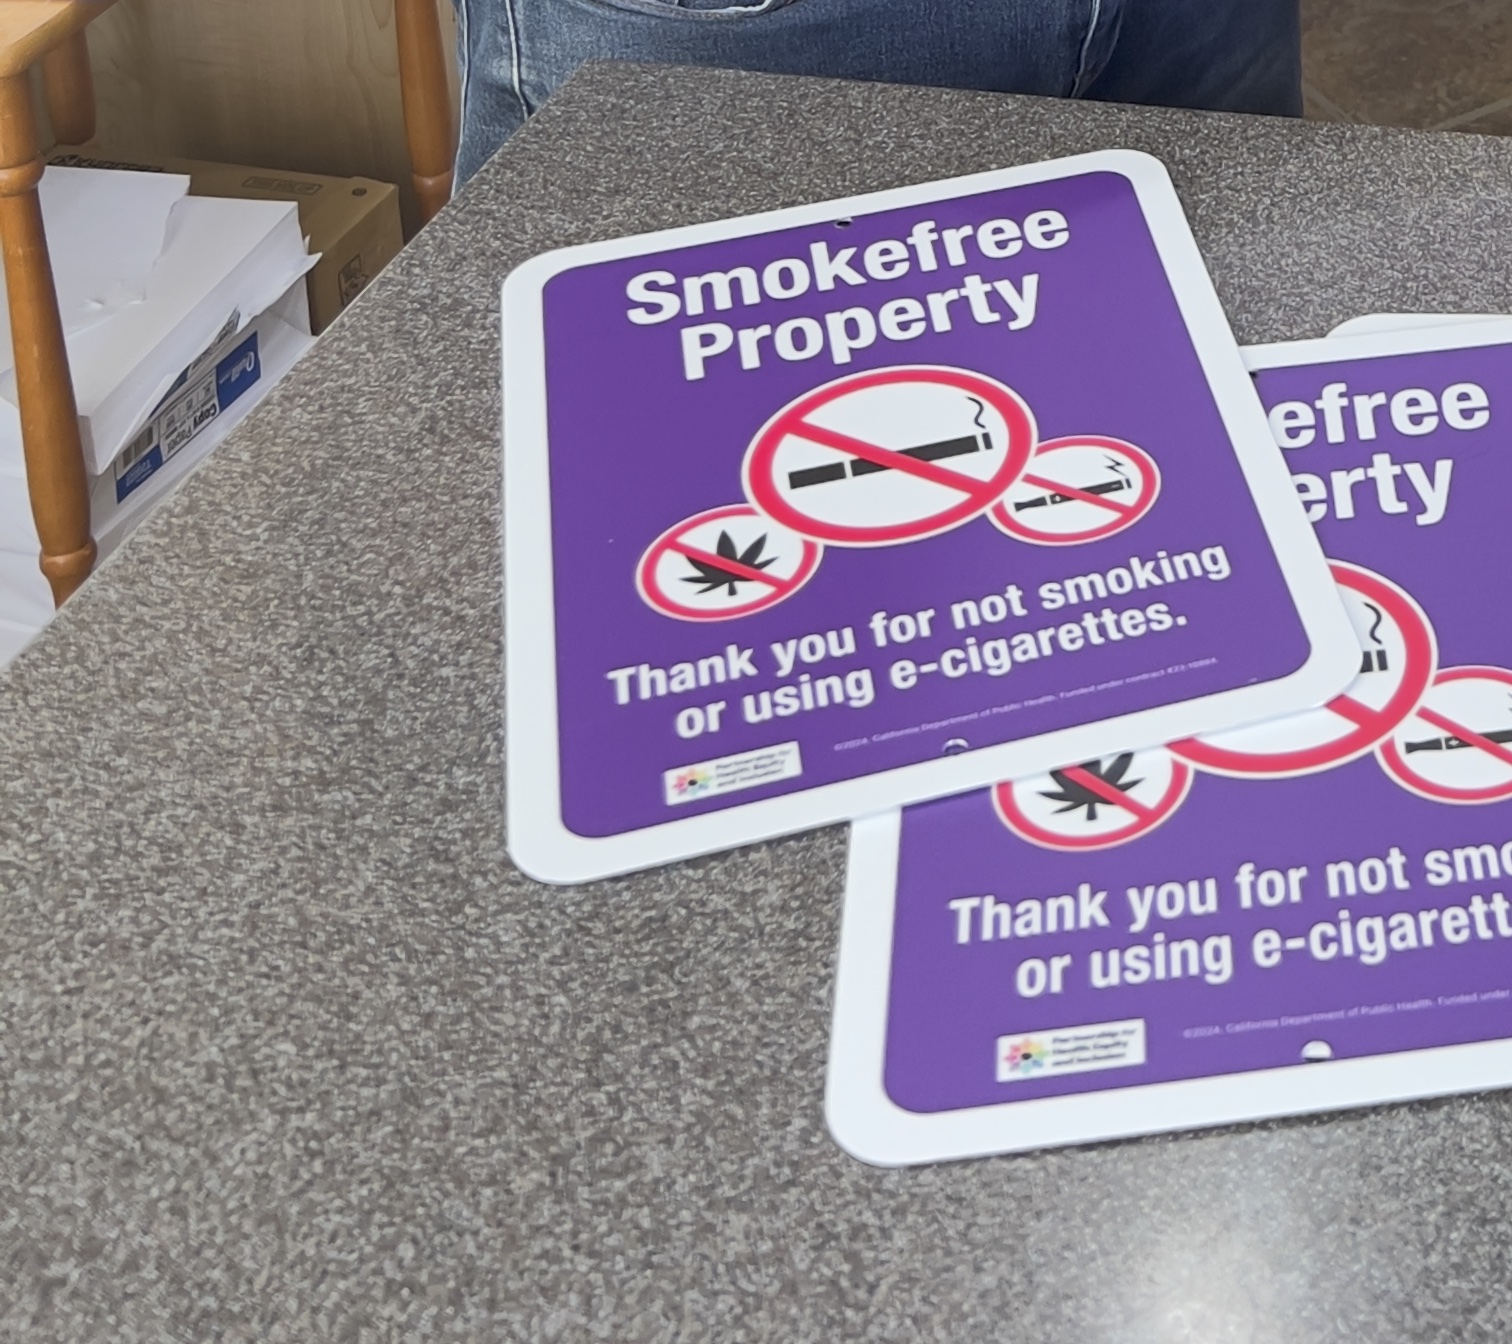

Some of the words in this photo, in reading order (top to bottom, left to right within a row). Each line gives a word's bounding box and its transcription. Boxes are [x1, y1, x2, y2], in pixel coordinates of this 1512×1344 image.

[626, 210, 1070, 325] Smokefree
[680, 274, 1039, 381] Property
[193, 403, 217, 430] Copy
[1268, 383, 1490, 449] efree
[1291, 453, 1453, 526] erty
[606, 644, 758, 705] Thank
[771, 627, 856, 678] you
[869, 608, 935, 647] for
[951, 585, 1027, 630] not
[1038, 545, 1231, 610] smoking
[676, 700, 726, 739] or
[743, 669, 875, 724] using
[890, 603, 1187, 690] e-cigarettes.
[949, 884, 1110, 944] Thank
[1127, 878, 1218, 933] you
[1235, 863, 1308, 909] for
[1327, 848, 1410, 898] not
[1017, 954, 1072, 998] or
[1091, 932, 1233, 988] using
